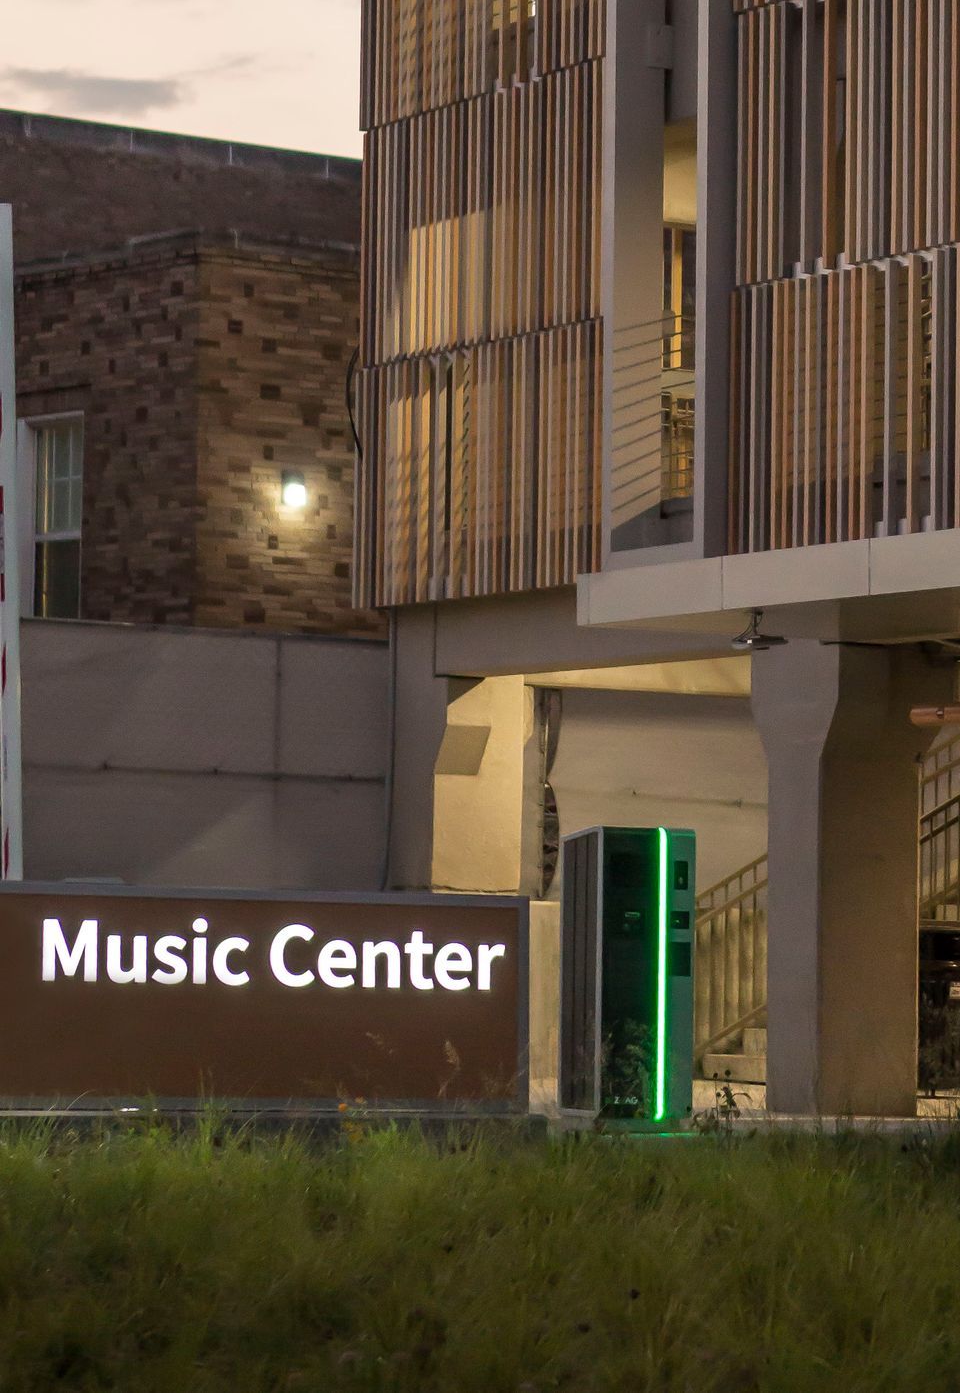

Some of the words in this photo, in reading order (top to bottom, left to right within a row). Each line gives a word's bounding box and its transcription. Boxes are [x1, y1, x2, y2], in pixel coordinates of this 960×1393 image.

[43, 918, 249, 986] Music
[270, 924, 505, 990] Center
[614, 1096, 638, 1105] ZAG
